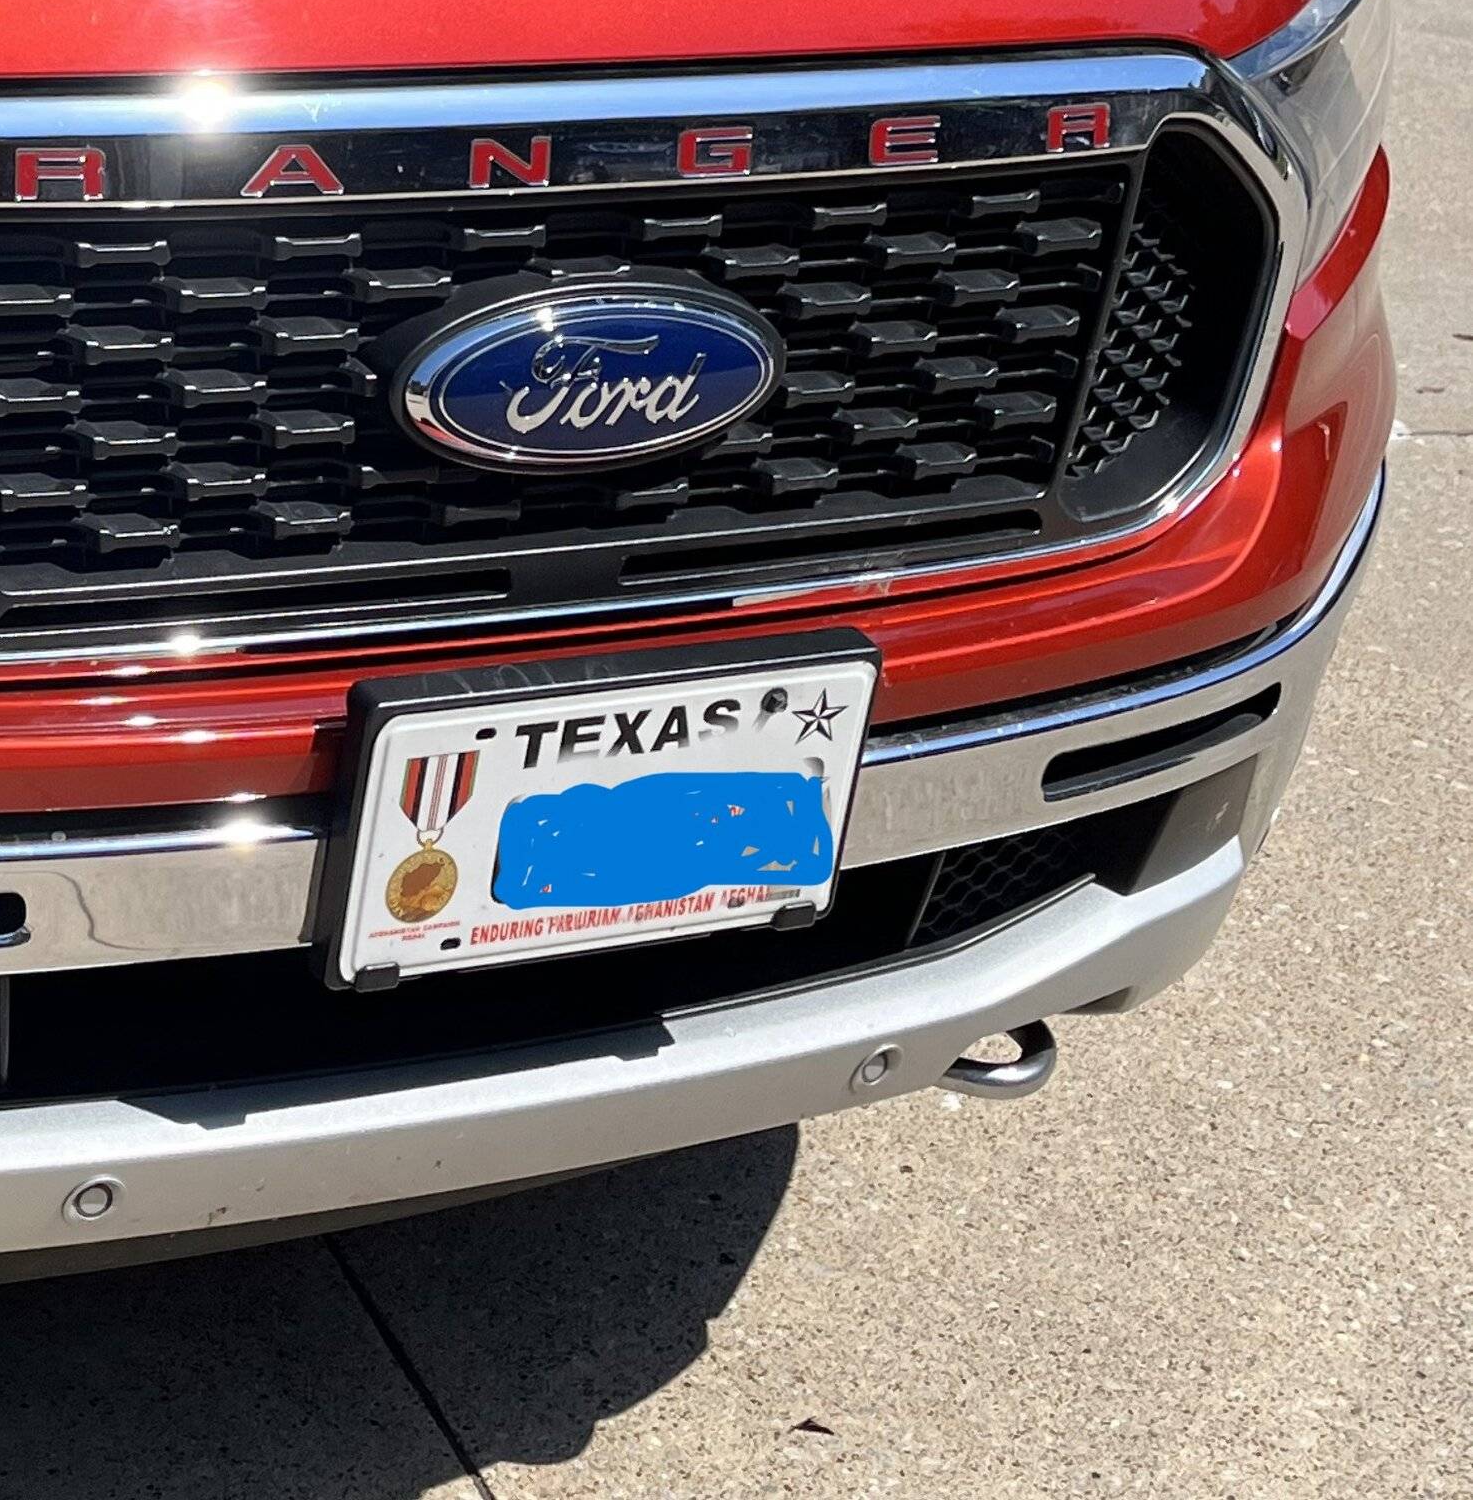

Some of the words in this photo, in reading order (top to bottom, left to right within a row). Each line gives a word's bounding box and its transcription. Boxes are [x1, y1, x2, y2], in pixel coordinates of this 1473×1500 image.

[14, 102, 1112, 200] RANGER
[499, 334, 707, 433] Ford
[515, 698, 742, 770] TEXAS
[470, 917, 544, 946] ENDURING
